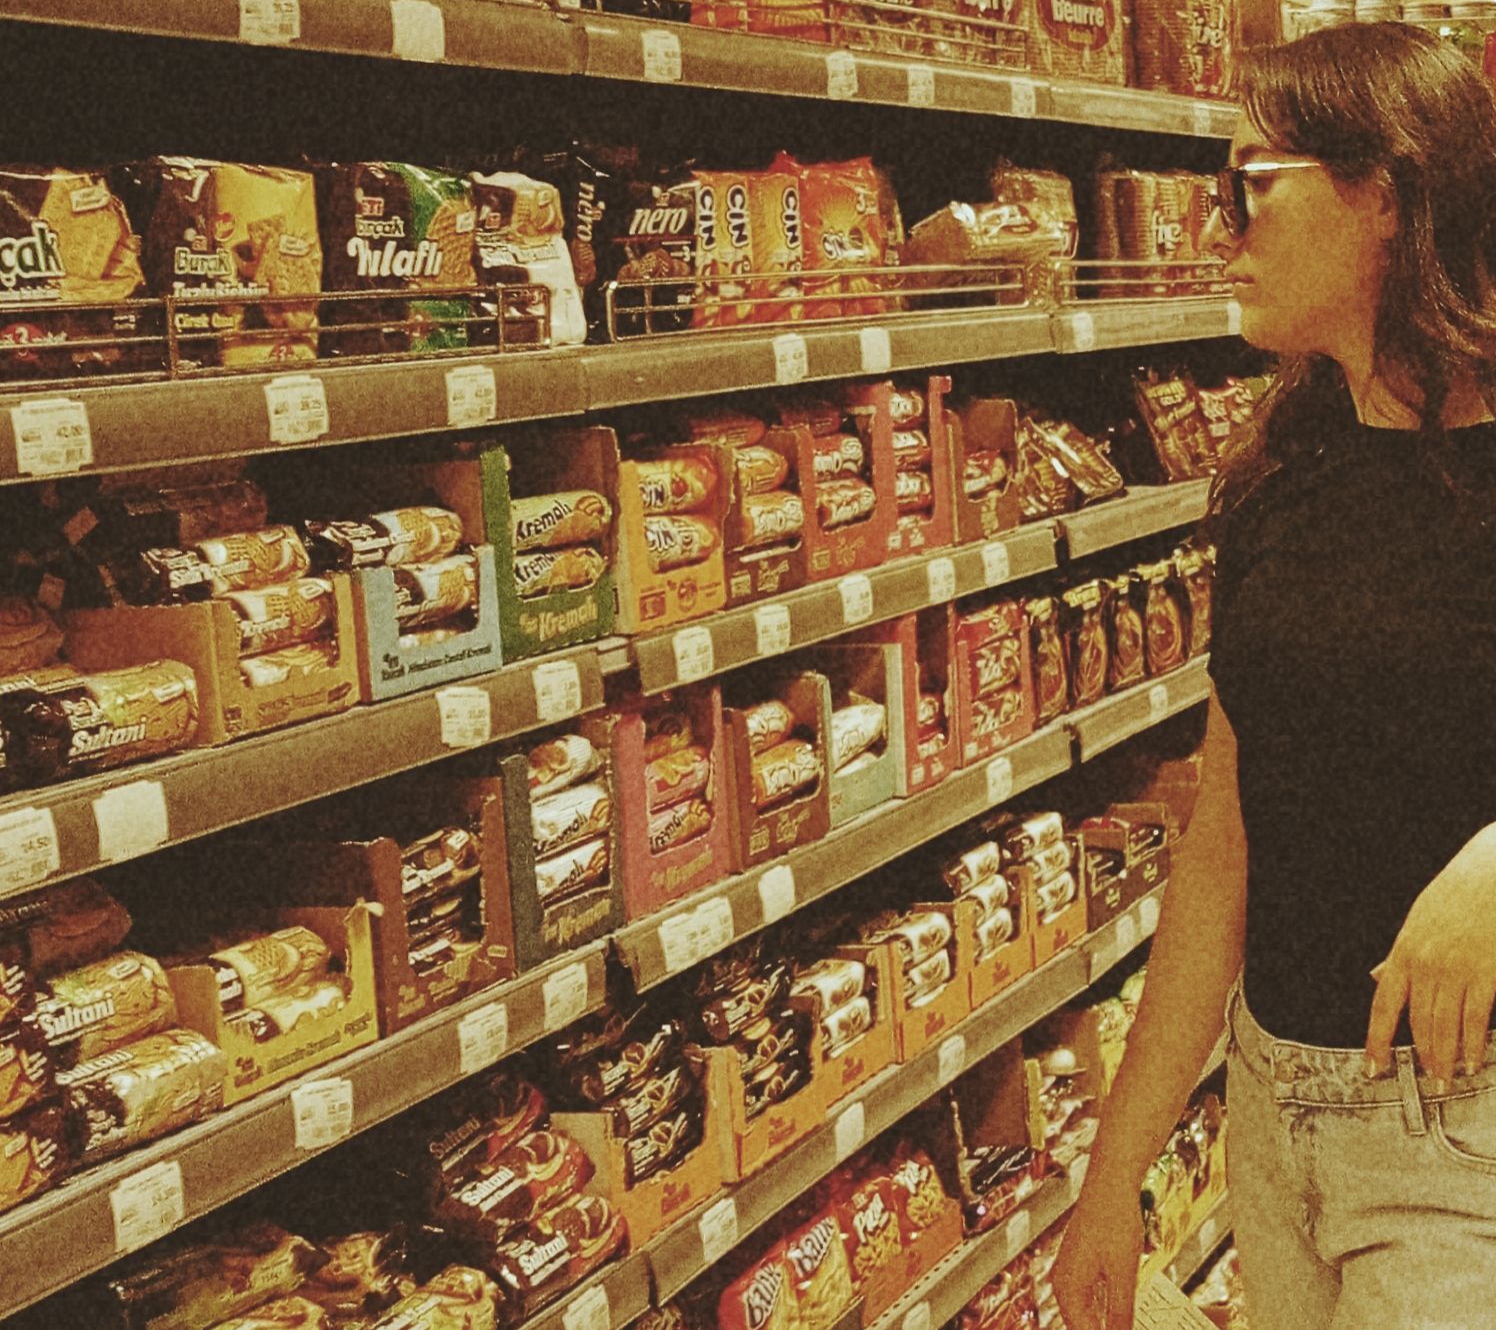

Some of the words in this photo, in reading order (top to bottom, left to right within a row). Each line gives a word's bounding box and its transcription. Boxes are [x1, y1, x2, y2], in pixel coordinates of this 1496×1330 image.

[629, 206, 687, 236] nero
[515, 499, 573, 542] Kremalı
[69, 716, 147, 757] Sultani
[38, 992, 115, 1040] Sultani
